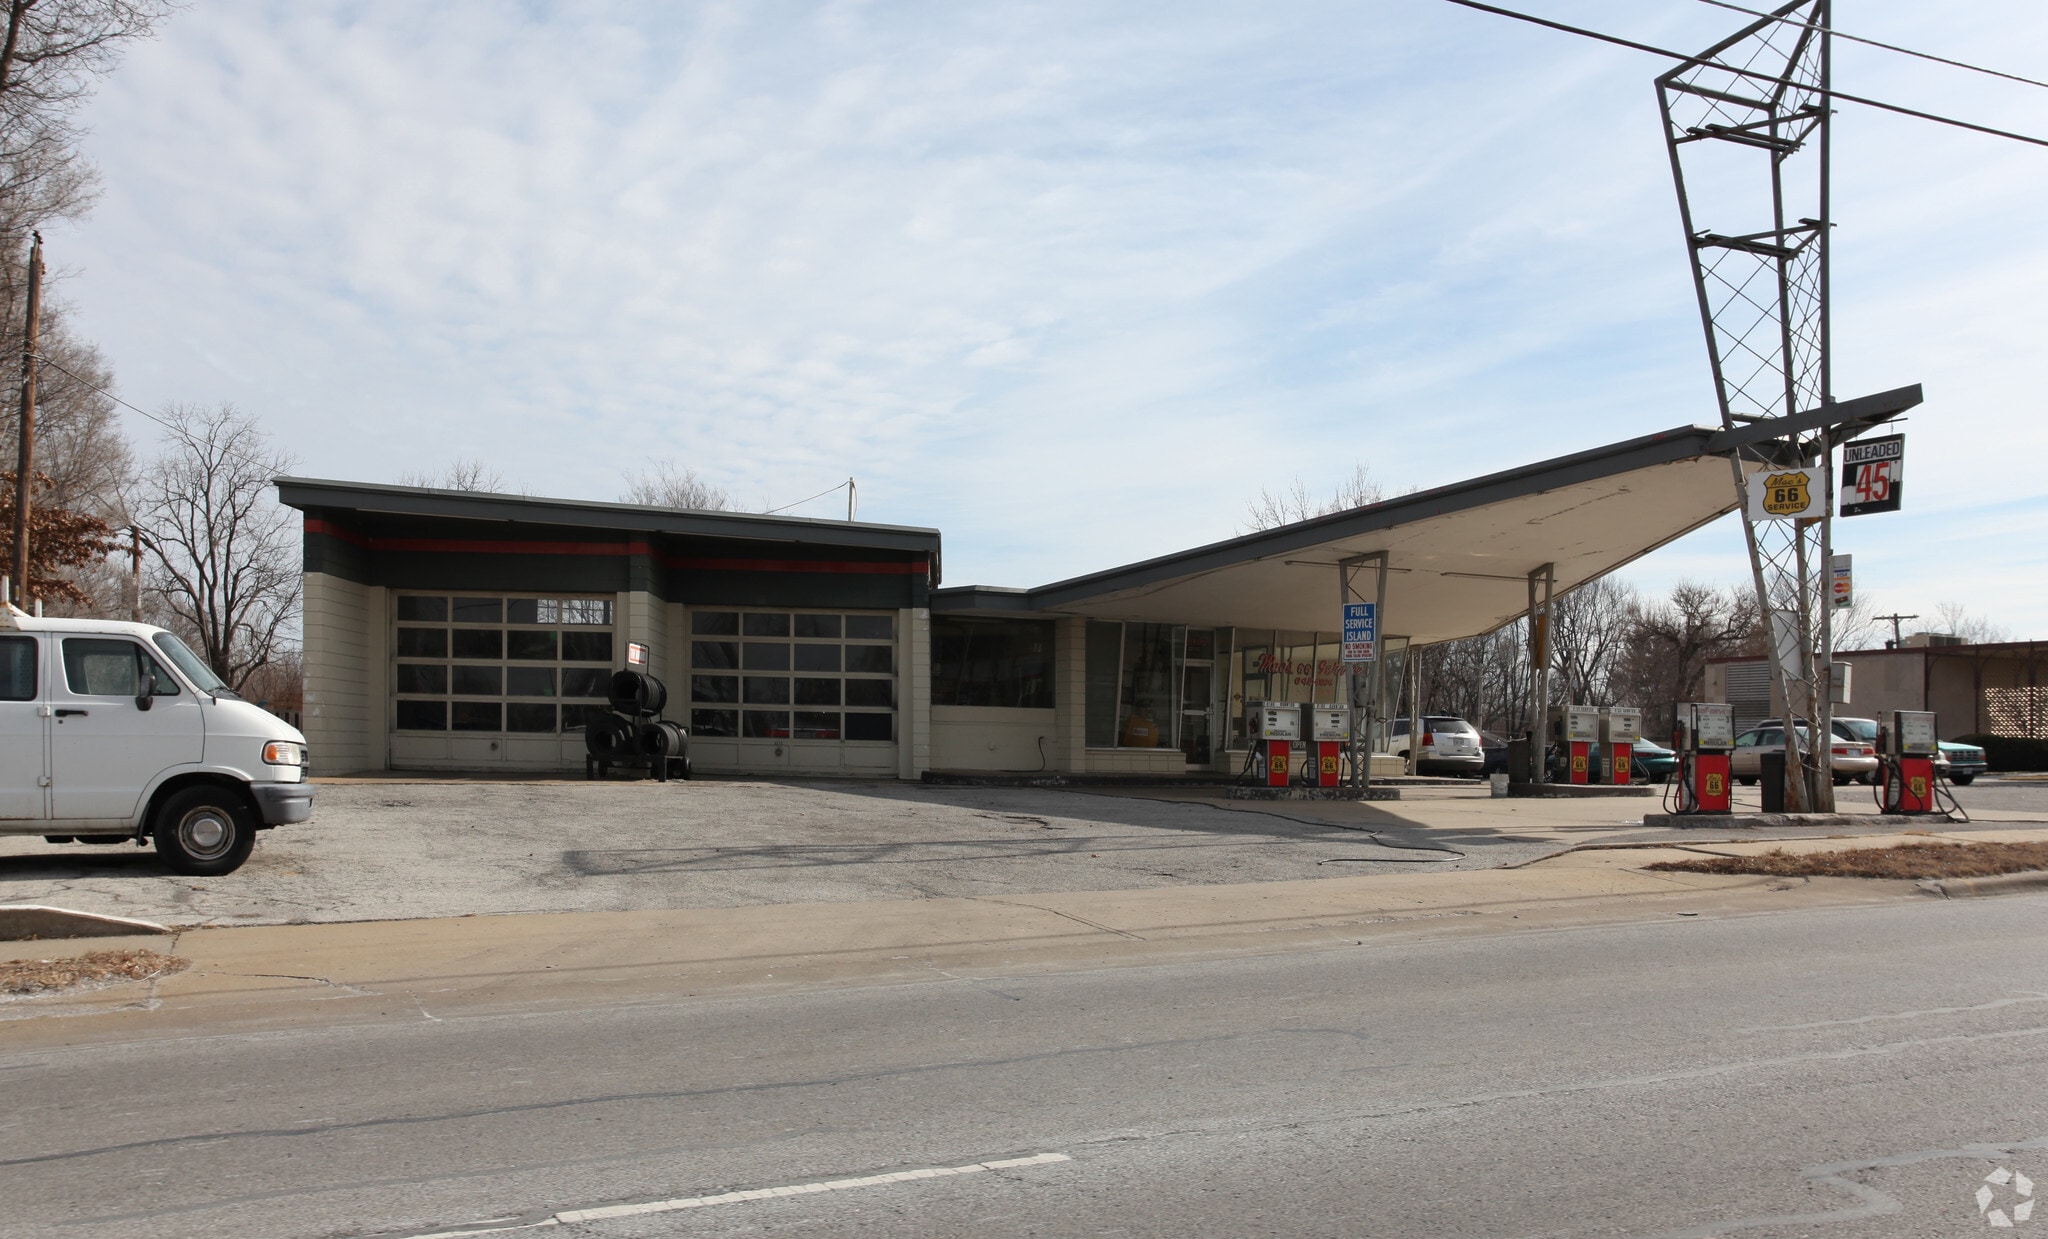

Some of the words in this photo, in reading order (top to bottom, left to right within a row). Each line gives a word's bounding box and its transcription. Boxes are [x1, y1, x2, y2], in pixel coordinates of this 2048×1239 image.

[1844, 442, 1900, 463] UNLEADED
[1770, 475, 1802, 486] Mac's
[1856, 461, 1889, 502] 45
[1774, 487, 1799, 503] 66
[1767, 502, 1806, 511] SERVICE
[1350, 606, 1369, 617] FULL
[1345, 618, 1373, 629] SERVICE
[1346, 631, 1372, 641] ISLAND
[1296, 663, 1312, 675] 66
[1292, 741, 1306, 749] OPEN
[1709, 781, 1719, 790] 66
